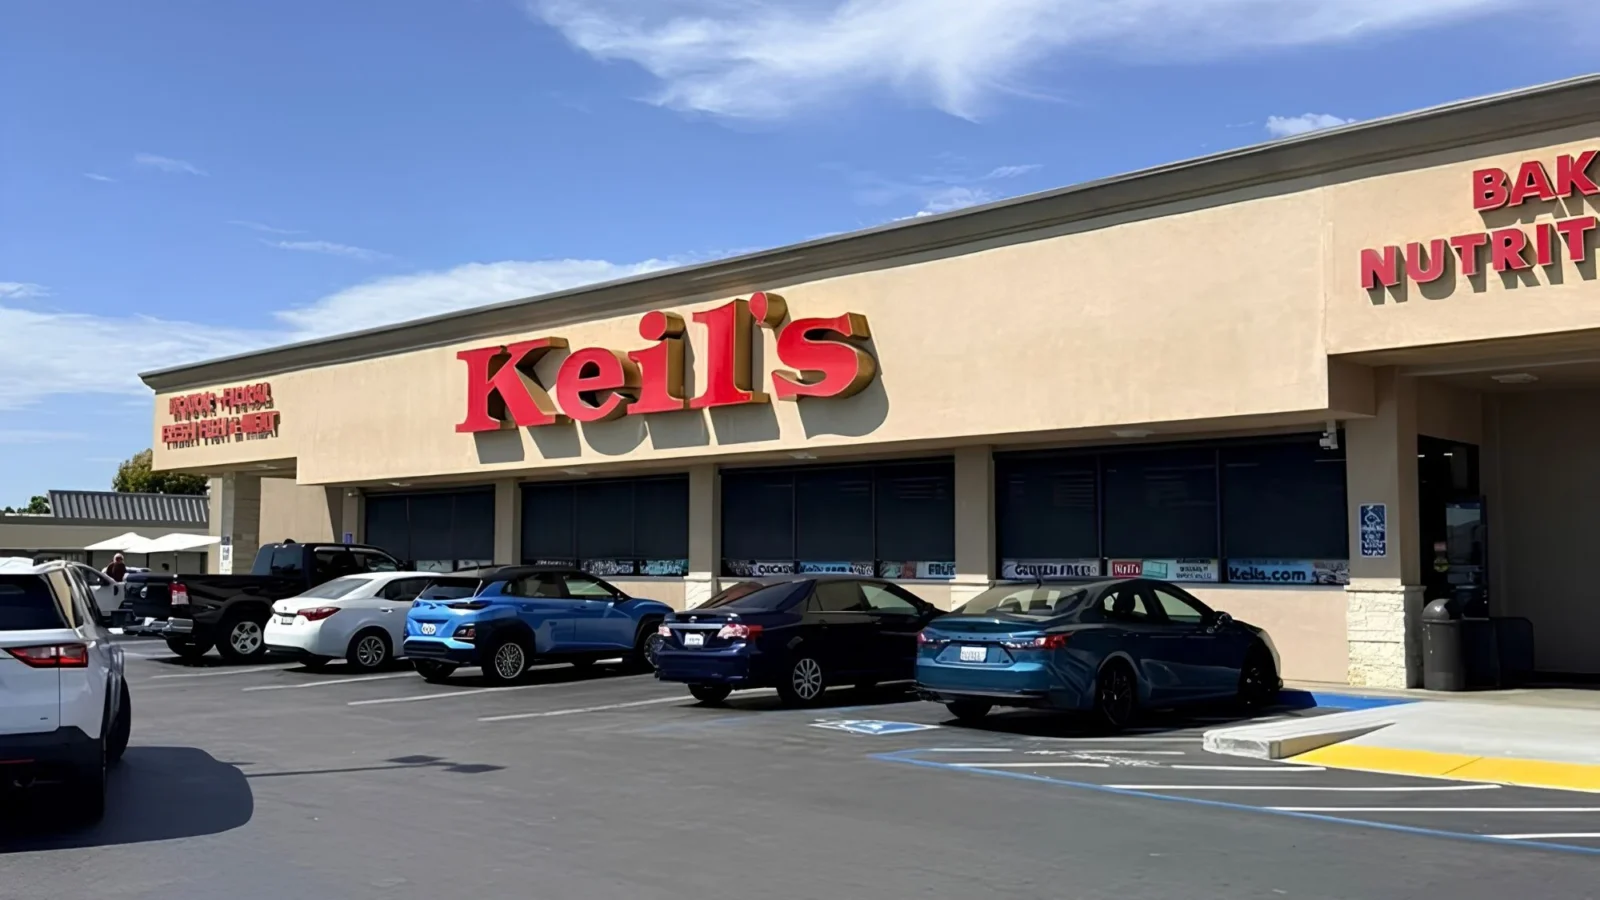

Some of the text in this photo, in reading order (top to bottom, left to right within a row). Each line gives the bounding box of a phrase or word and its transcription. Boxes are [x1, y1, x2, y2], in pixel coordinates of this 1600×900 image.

[1473, 150, 1600, 210] BAK
[1361, 216, 1596, 288] NUTRIT
[455, 292, 876, 433] Keil's
